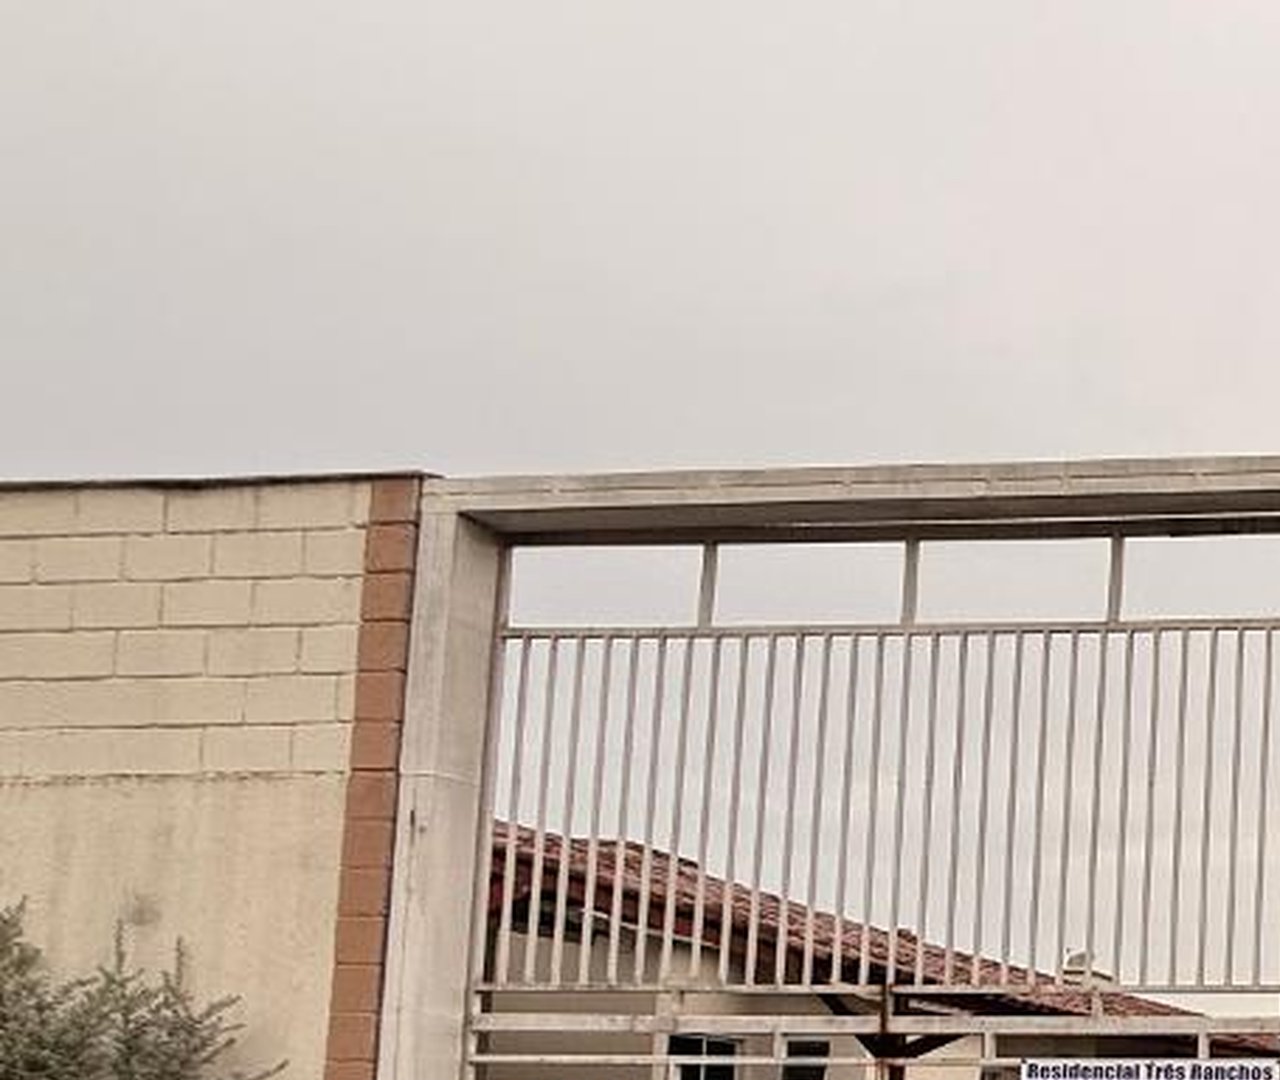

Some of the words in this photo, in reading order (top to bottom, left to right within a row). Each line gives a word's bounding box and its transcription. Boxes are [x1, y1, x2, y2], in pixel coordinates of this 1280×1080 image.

[1027, 1061, 1141, 1080] Residencial
[1145, 1060, 1185, 1080] Três
[1189, 1061, 1273, 1080] Ranchos
